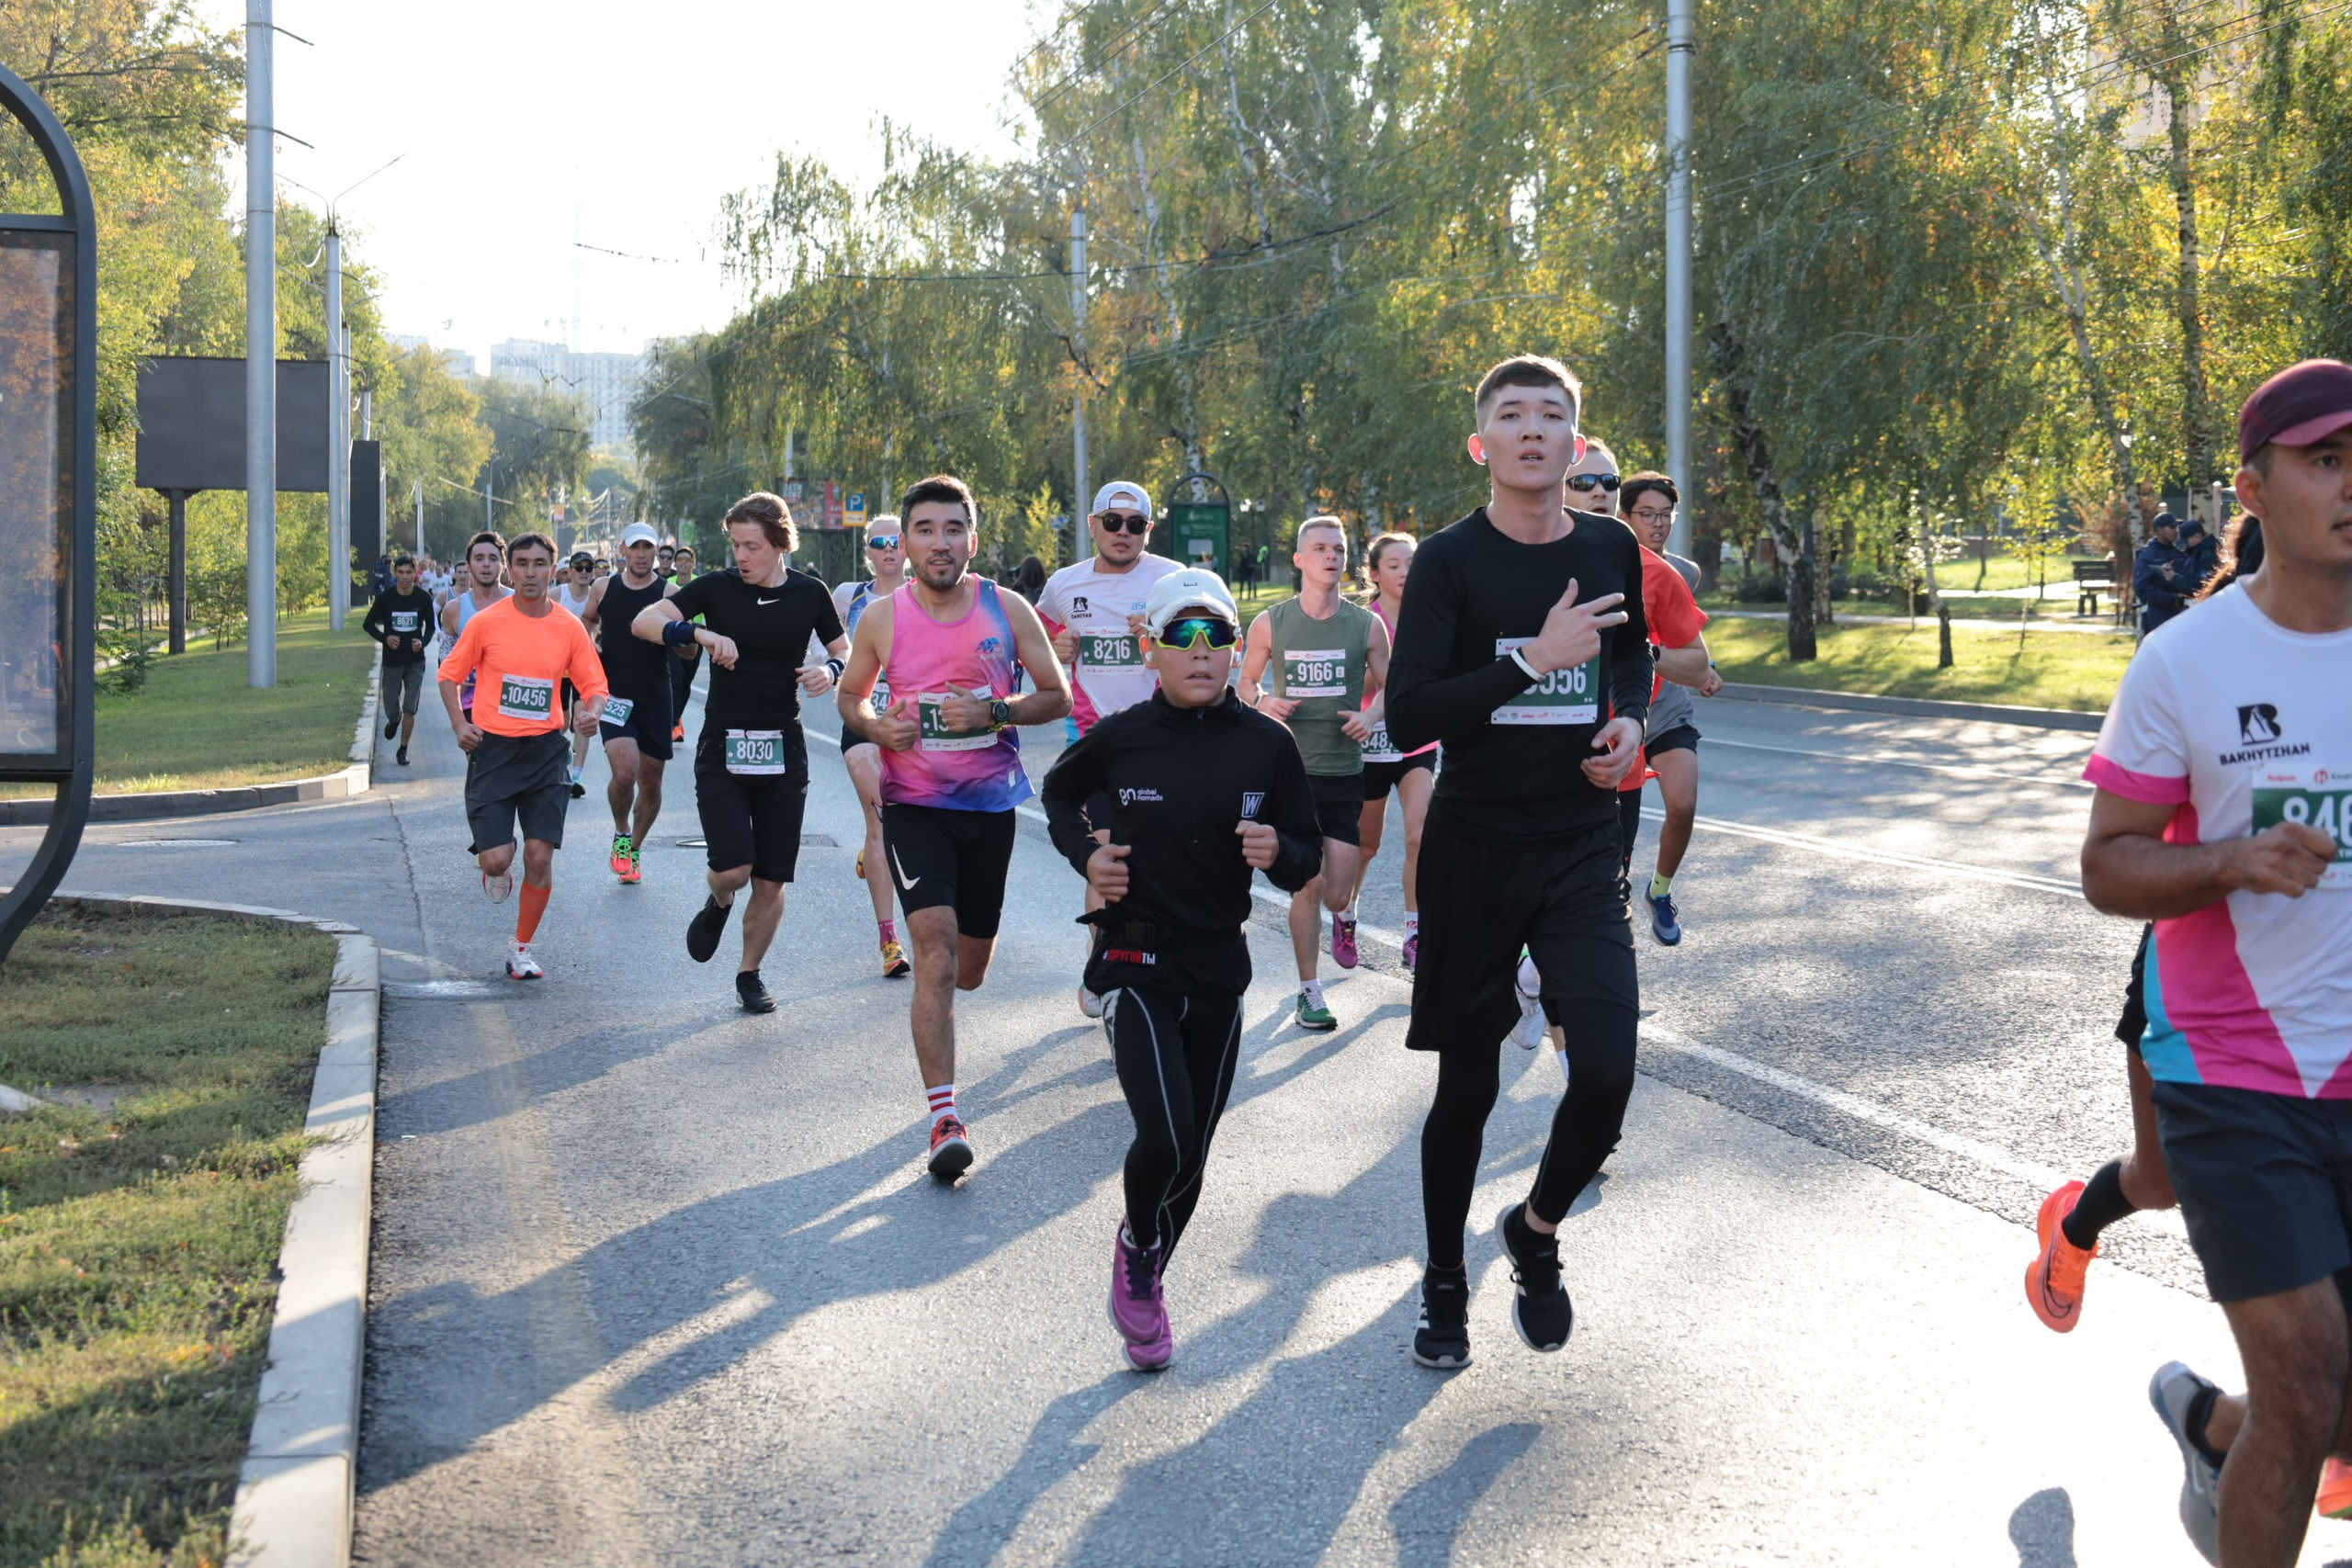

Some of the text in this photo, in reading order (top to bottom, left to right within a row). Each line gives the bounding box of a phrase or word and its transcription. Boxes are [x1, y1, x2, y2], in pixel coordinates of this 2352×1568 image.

[850, 494, 862, 510] P
[397, 616, 413, 626] 8621
[1093, 638, 1131, 660] 8216
[1297, 661, 1333, 682] 9166
[508, 685, 547, 707] 10456
[872, 693, 888, 711] 34
[605, 700, 628, 717] 525
[737, 740, 774, 761] 8030
[2220, 743, 2311, 766] BAKHYTZHAN
[1136, 788, 1157, 796] global
